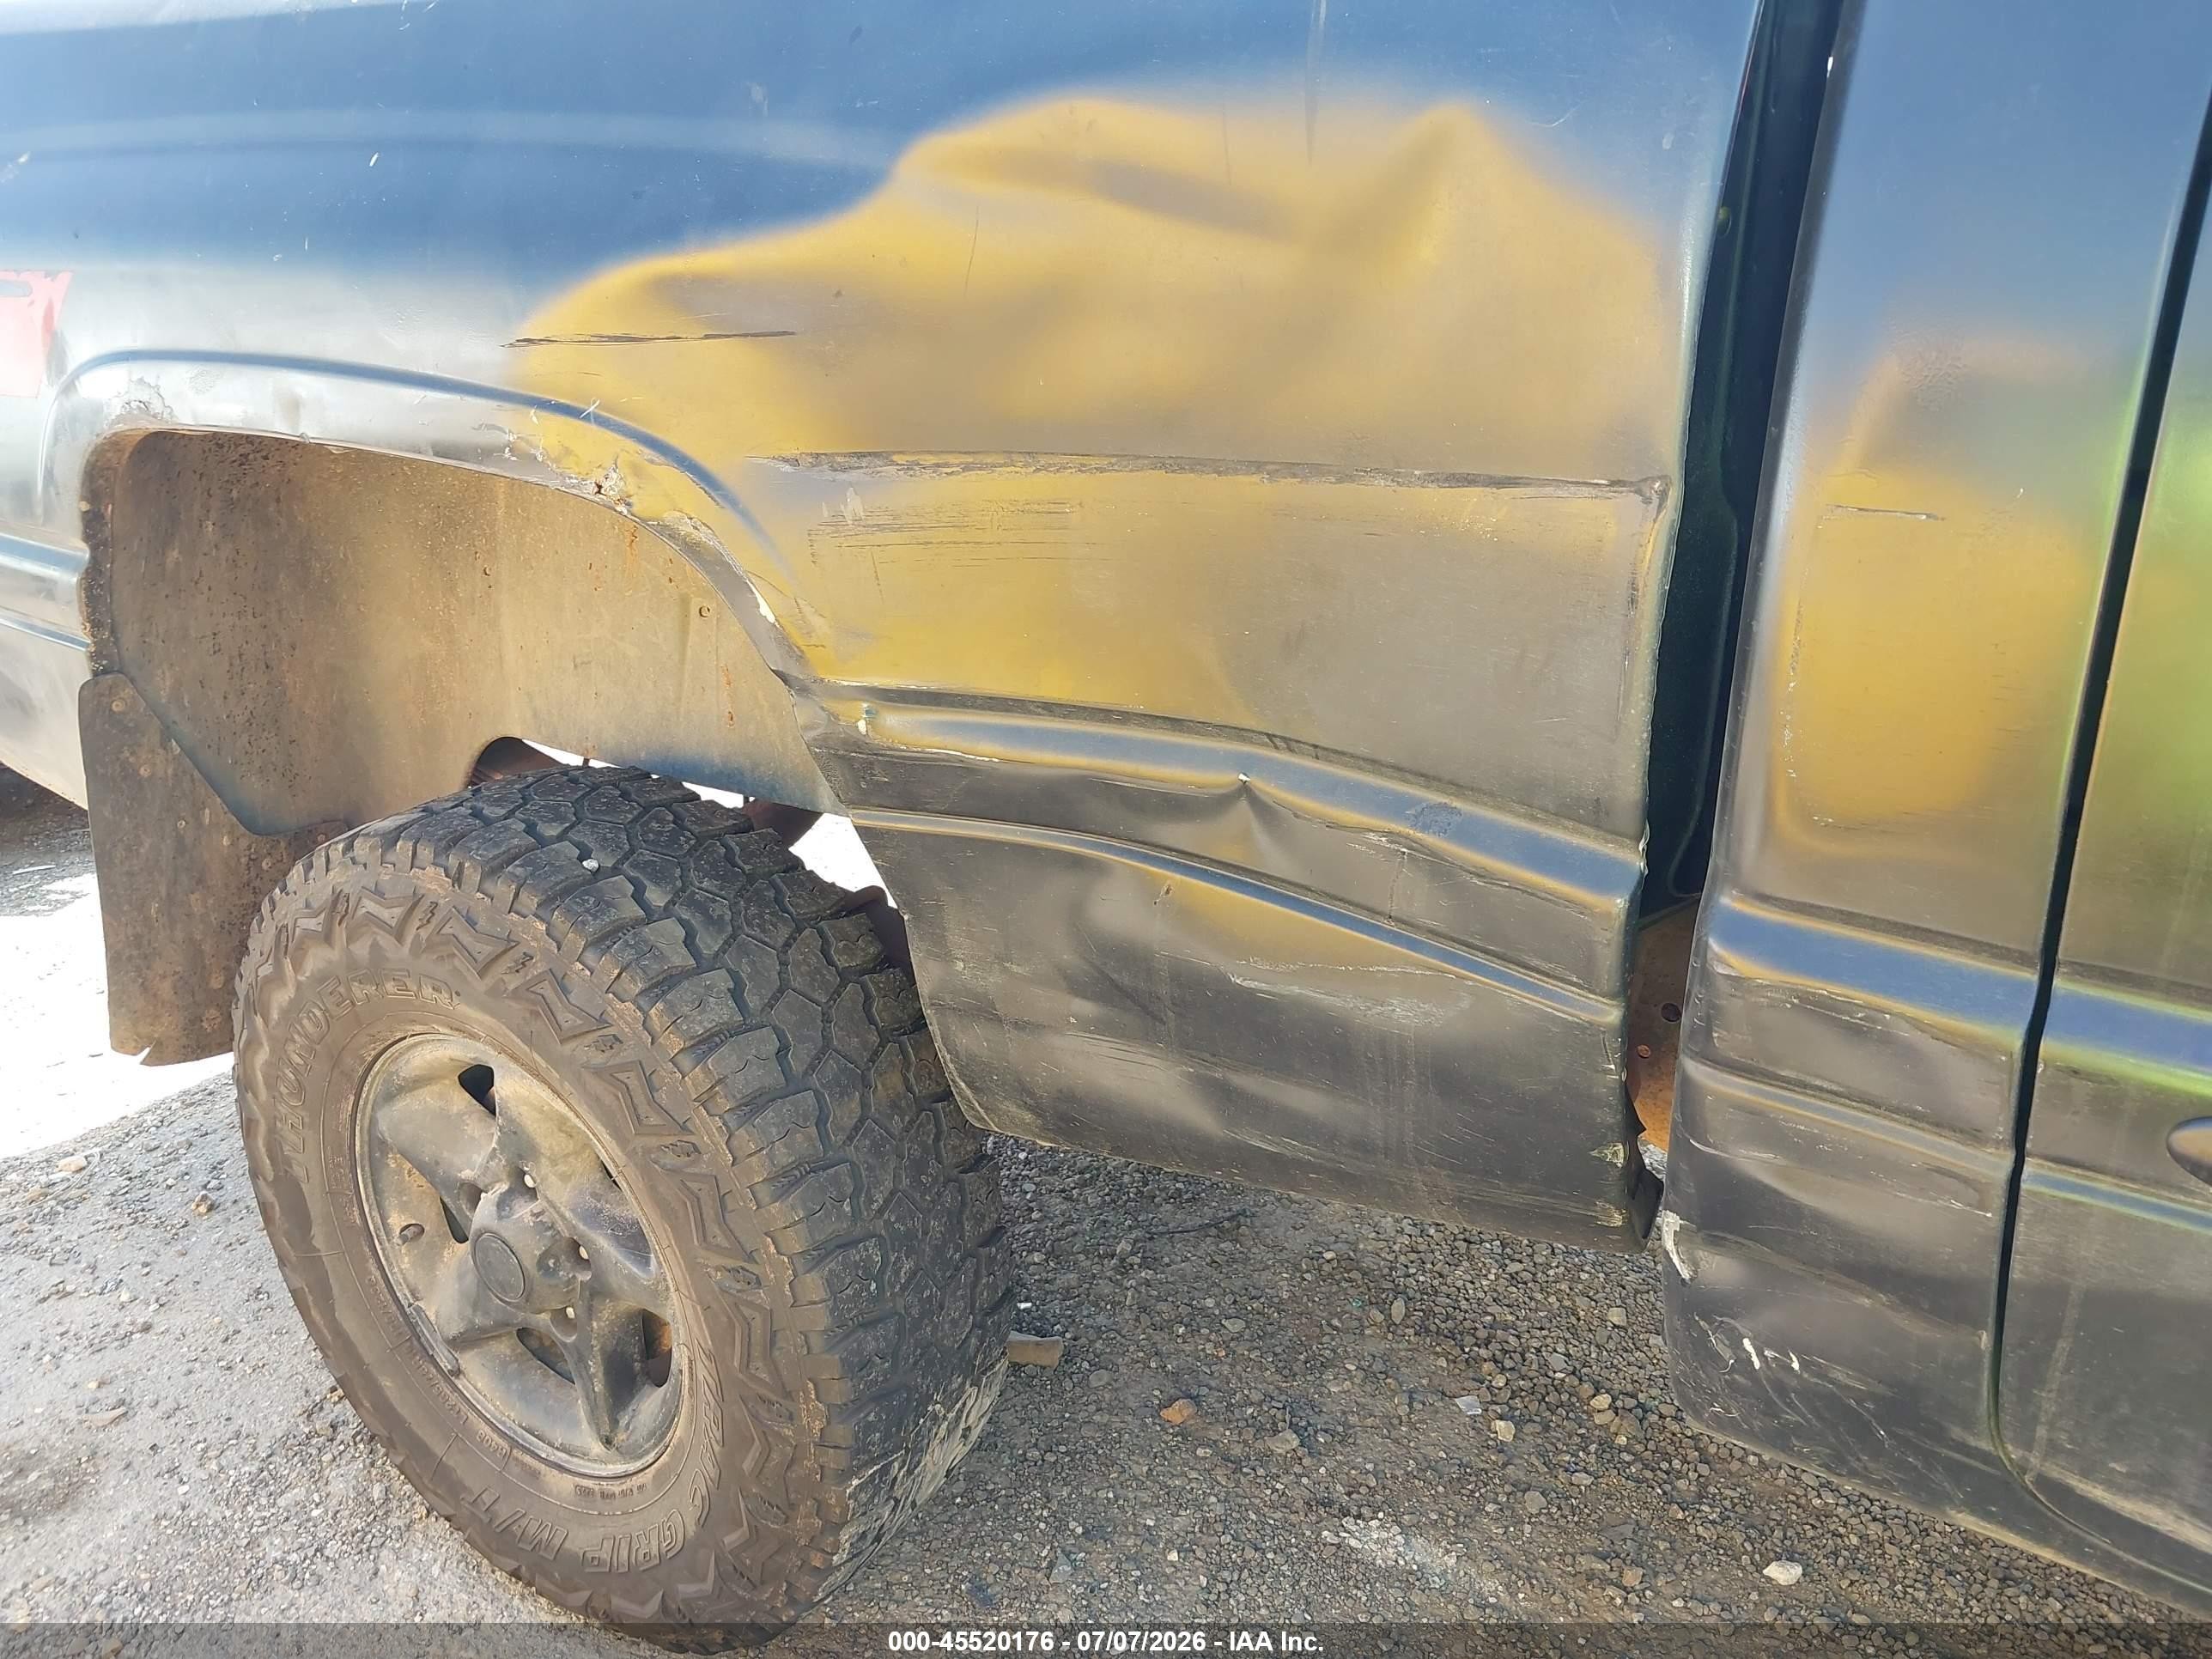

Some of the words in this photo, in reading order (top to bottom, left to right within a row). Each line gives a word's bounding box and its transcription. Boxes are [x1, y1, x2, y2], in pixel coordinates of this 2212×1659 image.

[274, 969, 460, 1184] THUNDERER
[460, 1486, 568, 1562] M/T
[580, 1508, 685, 1573] GRIP
